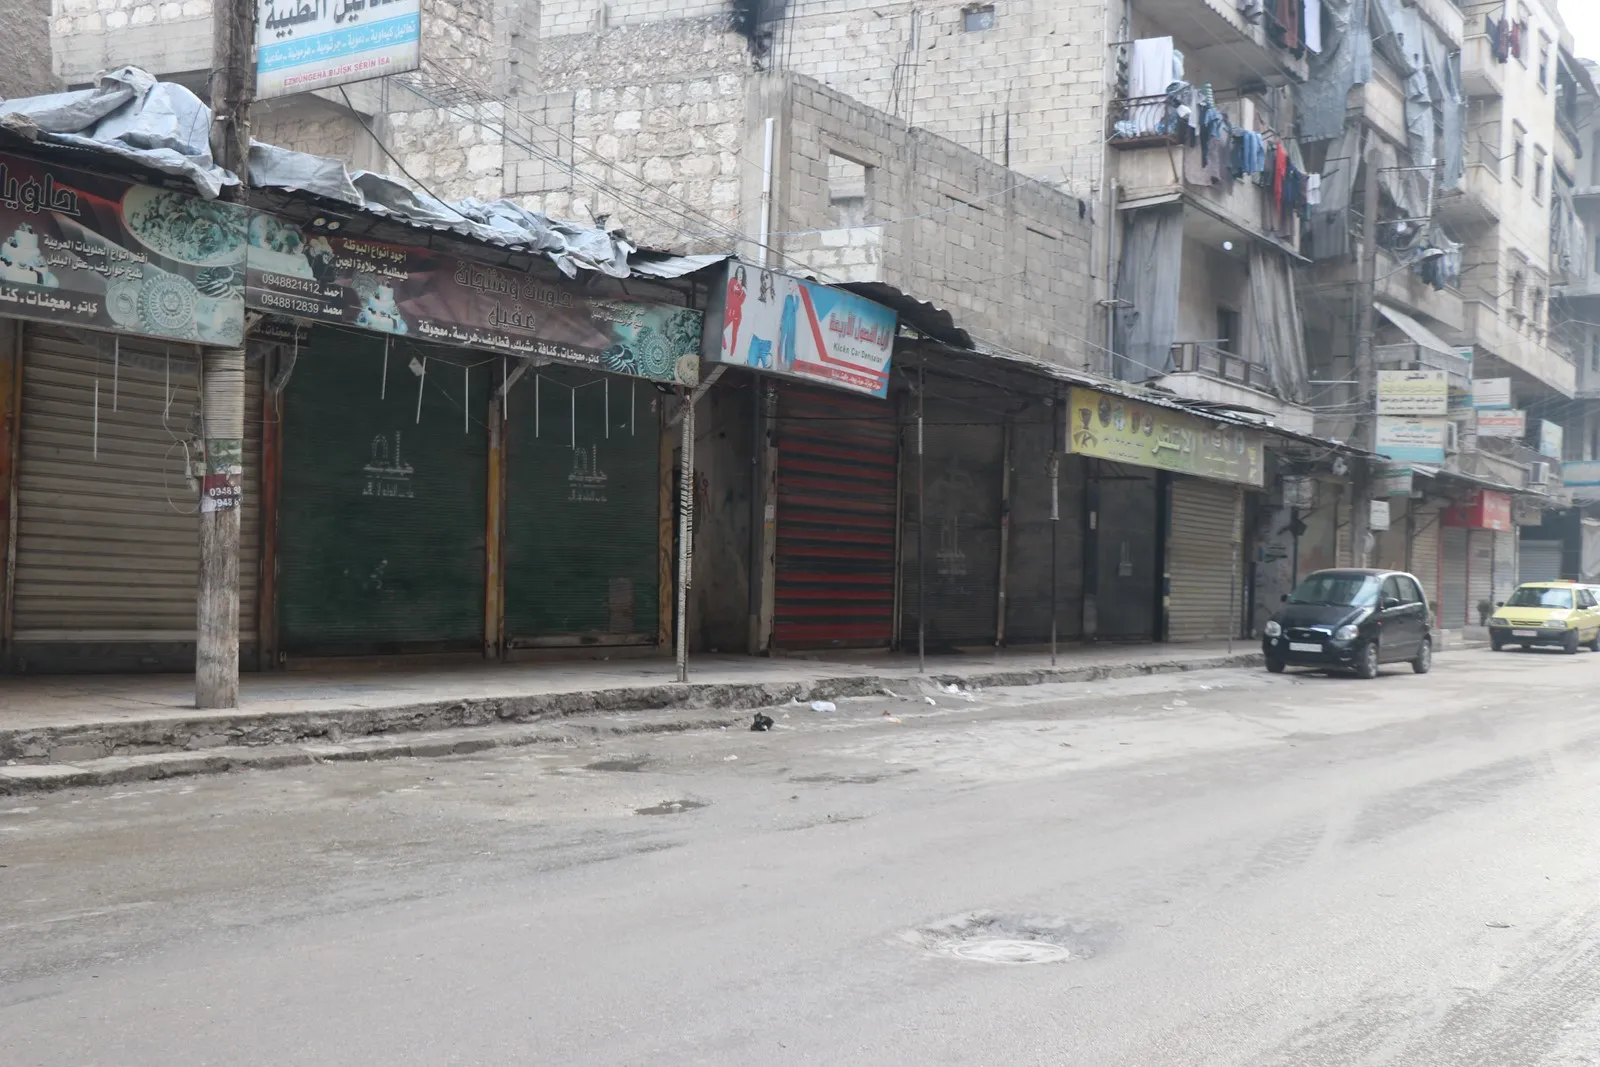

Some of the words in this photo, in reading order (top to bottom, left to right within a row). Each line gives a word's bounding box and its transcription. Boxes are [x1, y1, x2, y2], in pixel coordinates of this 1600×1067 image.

[262, 273, 320, 294] 0948821412
[324, 287, 344, 298] أحمد
[261, 293, 319, 314] 0948812839
[323, 305, 343, 316] محمد
